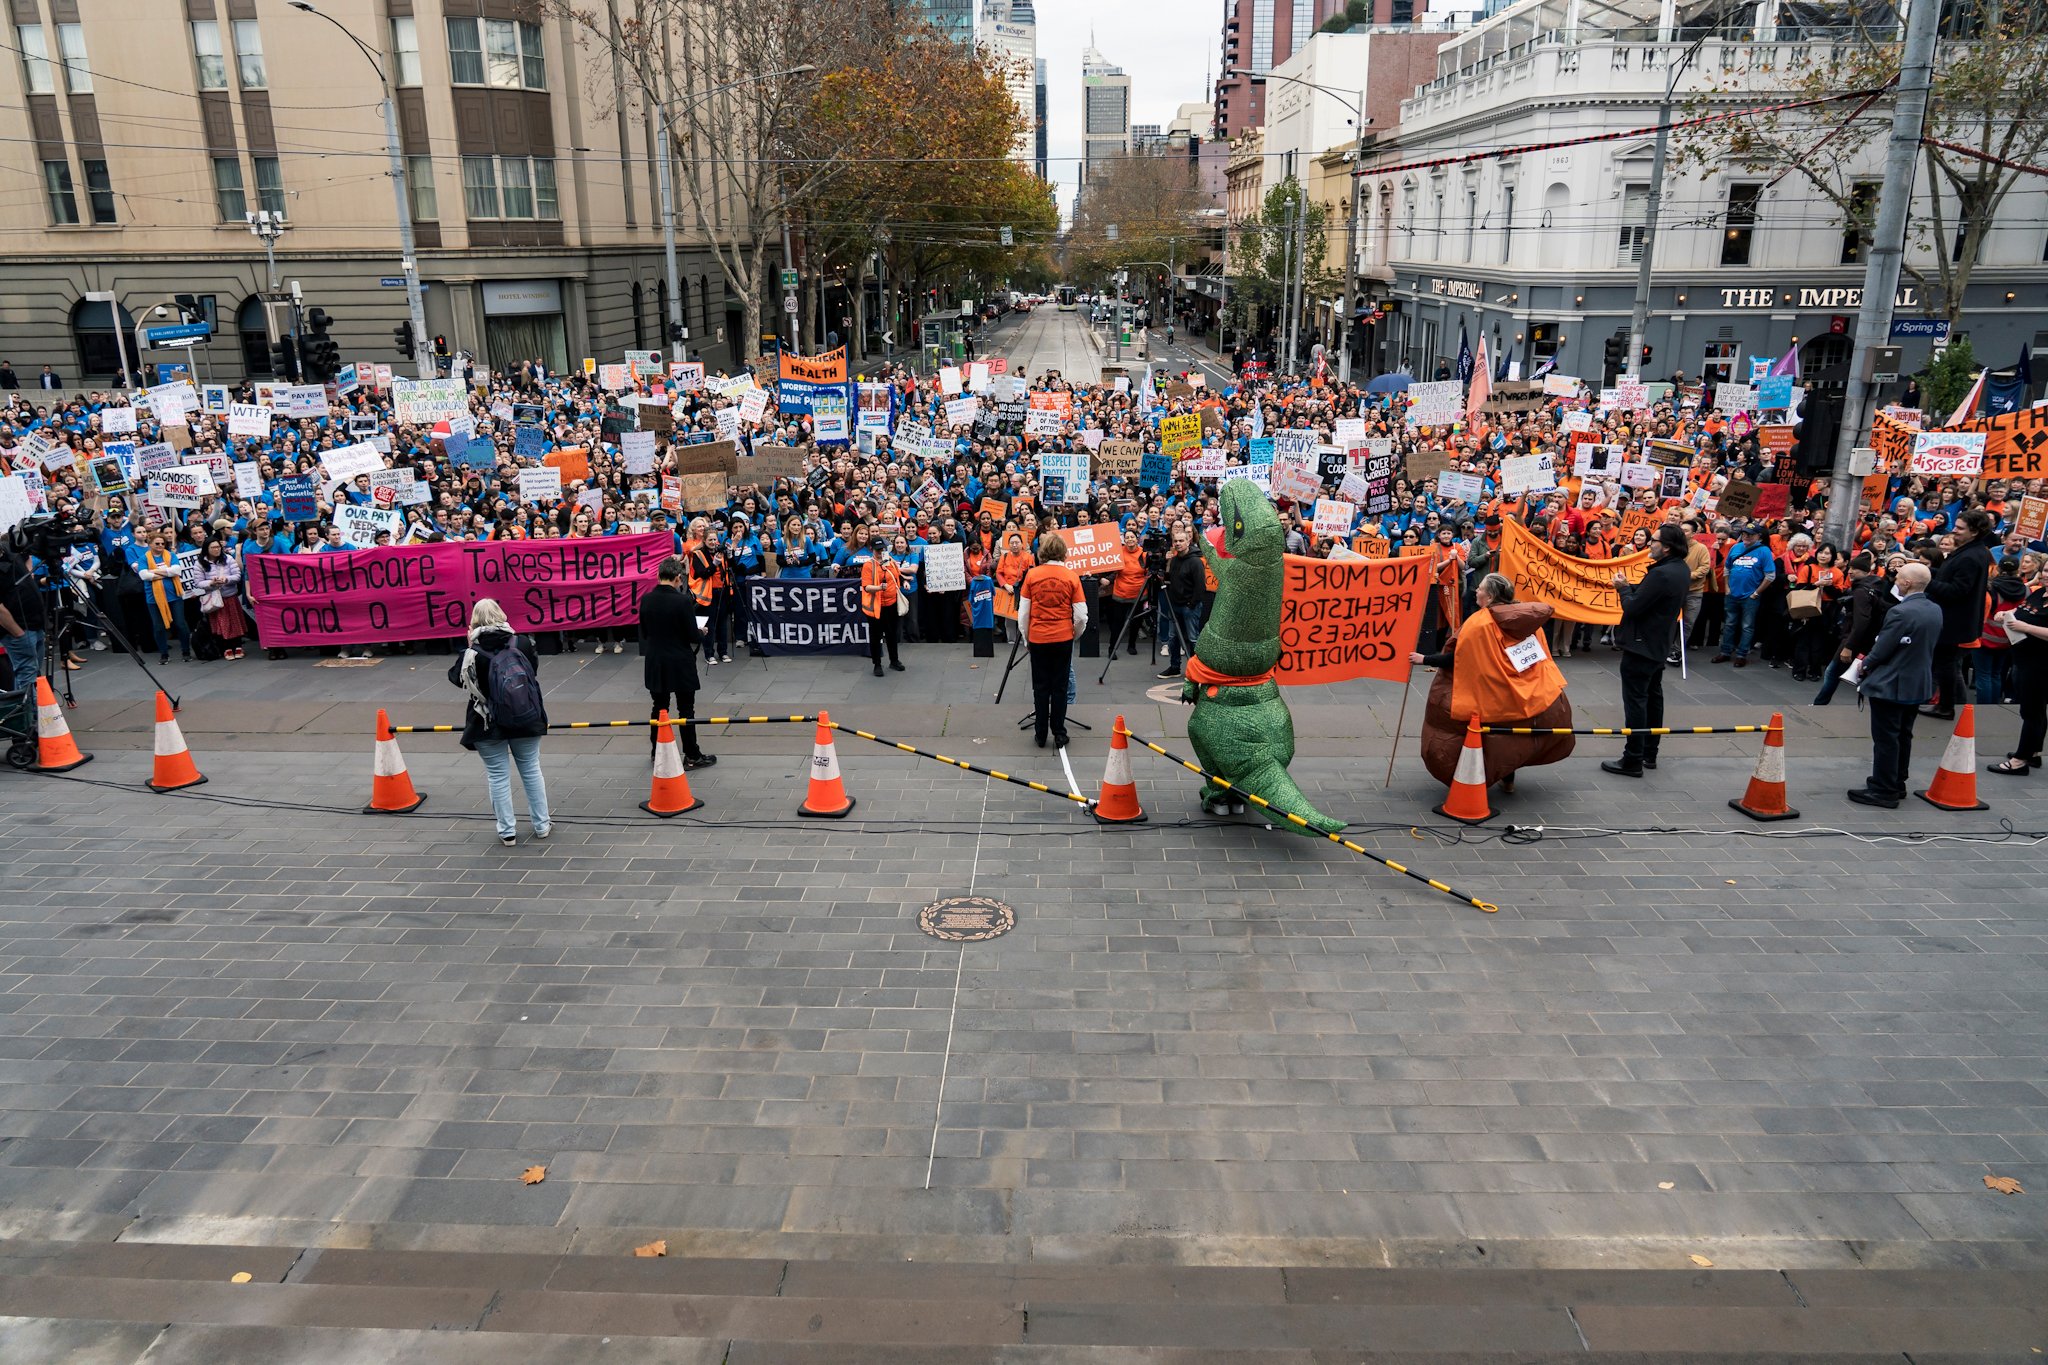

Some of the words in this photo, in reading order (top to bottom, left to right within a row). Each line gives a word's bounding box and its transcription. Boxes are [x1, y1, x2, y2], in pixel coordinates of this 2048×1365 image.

[1003, 26, 1026, 36] UniSuper
[1552, 156, 1569, 165] 1863
[1447, 280, 1477, 299] IMPERIAL
[1721, 289, 1773, 307] THE
[1901, 323, 1932, 333] Spring
[1936, 322, 1947, 331] St
[791, 365, 837, 379] HEALTH
[1409, 382, 1460, 396] PHARMACISTS
[781, 394, 801, 404] FAIR
[1423, 396, 1447, 405] PREVENT
[1507, 392, 1527, 400] WAGES
[233, 407, 269, 418] WTF?
[1008, 404, 1024, 412] SONO
[1412, 403, 1454, 414] MEDICATION
[1415, 412, 1450, 425] DEATHS
[1578, 434, 1597, 442] PAY
[1918, 434, 1984, 449] Discharge
[1104, 446, 1117, 456] WE
[1277, 438, 1313, 453] HEAVY
[1935, 447, 1960, 456] THE
[1043, 456, 1071, 466] RESPECT
[1078, 457, 1087, 467] US
[1349, 448, 1369, 465] 99
[1102, 458, 1115, 468] PAY
[1117, 459, 1137, 468] RENT
[1143, 460, 1166, 470] VOICE
[1327, 464, 1347, 474] CODE
[1369, 457, 1389, 471] OVER
[1913, 455, 1980, 472] disrespect
[1078, 470, 1087, 480] US
[1227, 467, 1248, 475] WE'VE
[1252, 465, 1267, 473] GOT
[1366, 468, 1390, 481] WORKED
[148, 471, 196, 484] DIAGNOSIS:
[1370, 478, 1388, 488] UNDER
[165, 484, 197, 495] CHRONIC
[285, 483, 312, 491] Assault
[1371, 488, 1385, 496] PAID
[1319, 504, 1334, 513] FAIR
[1337, 505, 1348, 513] PAY
[346, 508, 368, 520] OUR
[371, 511, 393, 522] PAY
[349, 520, 378, 531] NEEDS
[1626, 513, 1640, 526] NO
[1641, 517, 1658, 530] TEST
[1067, 545, 1095, 556] TAND
[1098, 542, 1112, 552] UP
[1359, 540, 1387, 552] ITCHY
[1066, 559, 1087, 569] GHT
[1090, 554, 1122, 566] BACK
[262, 554, 436, 595] Healthcare
[464, 548, 553, 583] Takes
[560, 546, 650, 581] Heart
[1526, 561, 1571, 584] COVID
[1576, 575, 1615, 589] HERO
[1515, 574, 1584, 605] PAYRISE
[1589, 591, 1621, 607] ZE
[751, 586, 862, 613] RESPEC
[281, 601, 341, 635] and
[370, 603, 389, 630] a
[426, 591, 477, 629] Fai
[524, 581, 639, 626] Start!
[747, 622, 814, 644] ALLIED
[818, 622, 869, 644] HEALT
[1510, 646, 1522, 657] VIC
[1522, 641, 1536, 652] GOV
[1521, 653, 1538, 665] OFFER
